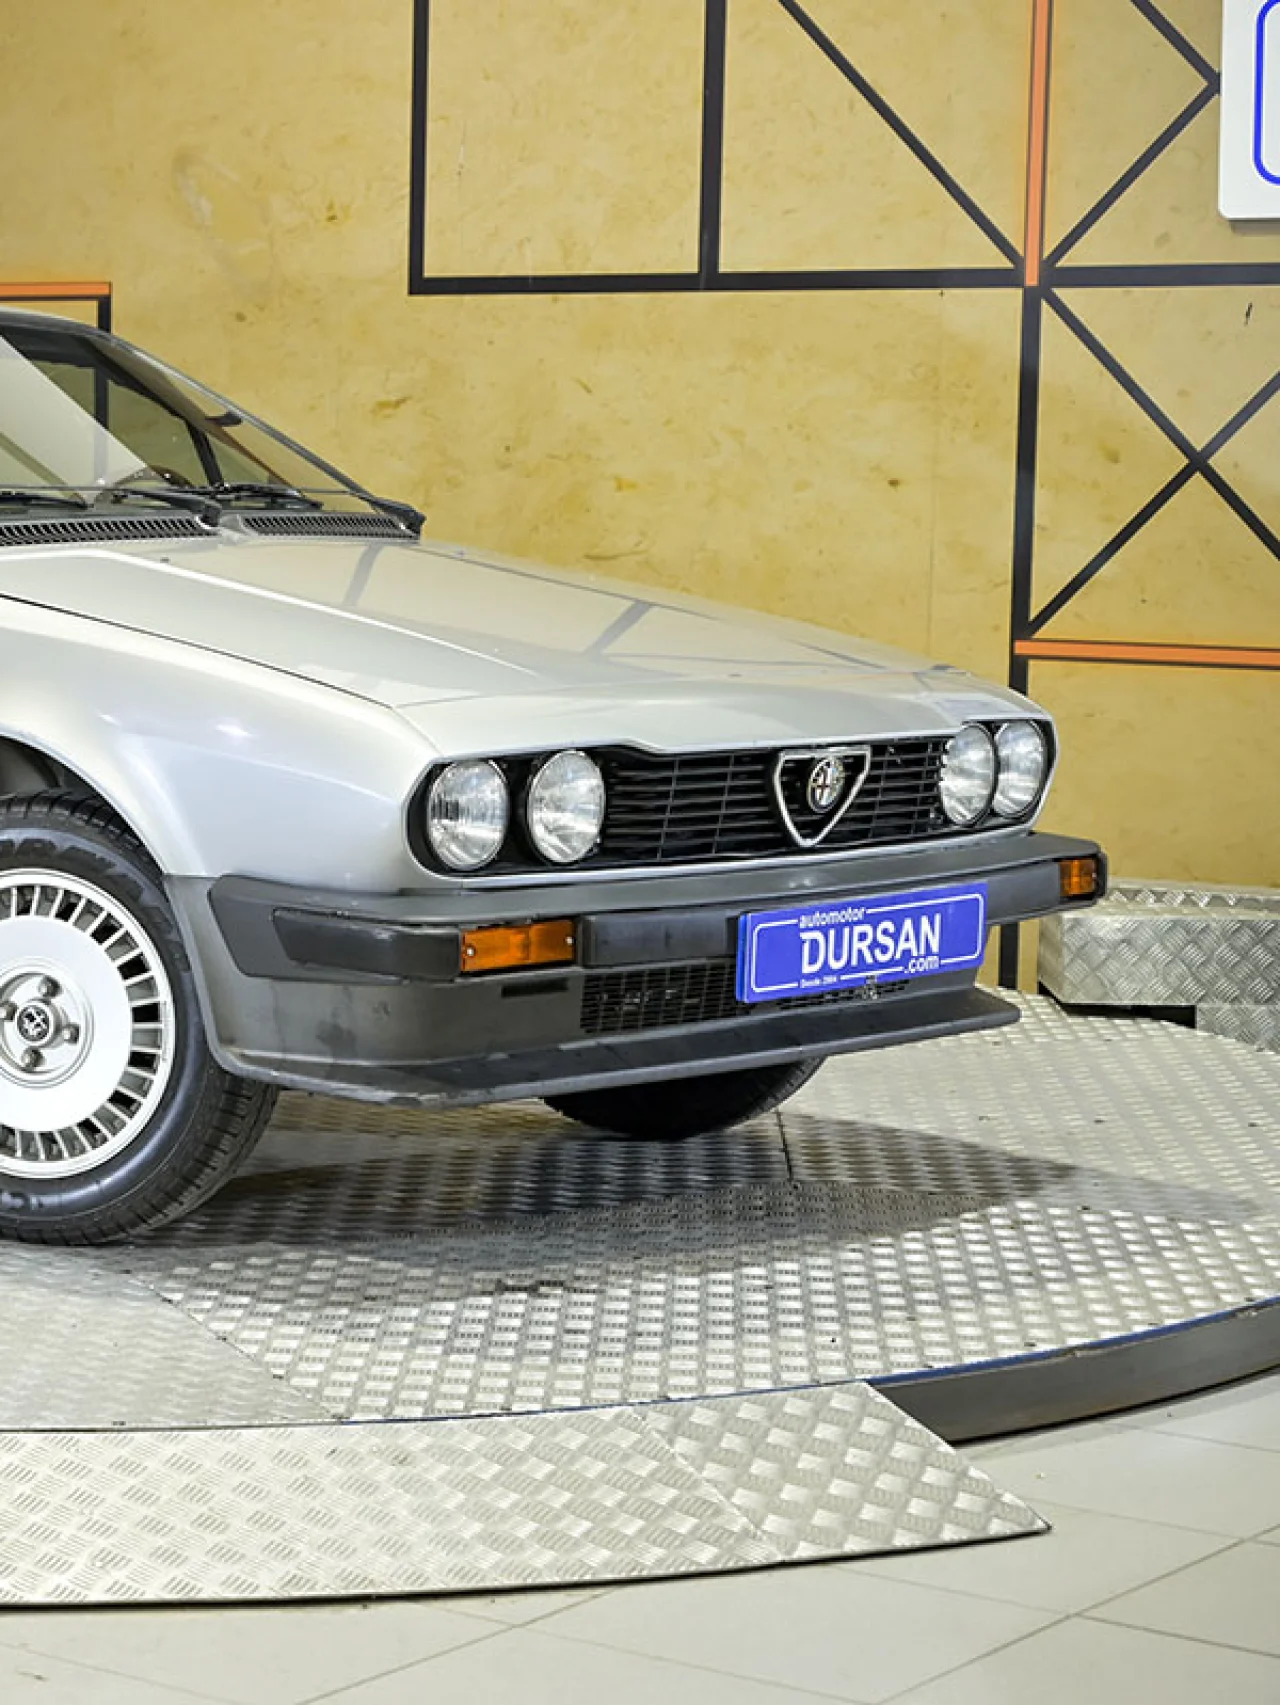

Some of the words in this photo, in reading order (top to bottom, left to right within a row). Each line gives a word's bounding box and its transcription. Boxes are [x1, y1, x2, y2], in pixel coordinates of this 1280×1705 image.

[800, 906, 865, 928] automotor
[800, 912, 942, 974] DURSAN
[904, 955, 940, 974] .com
